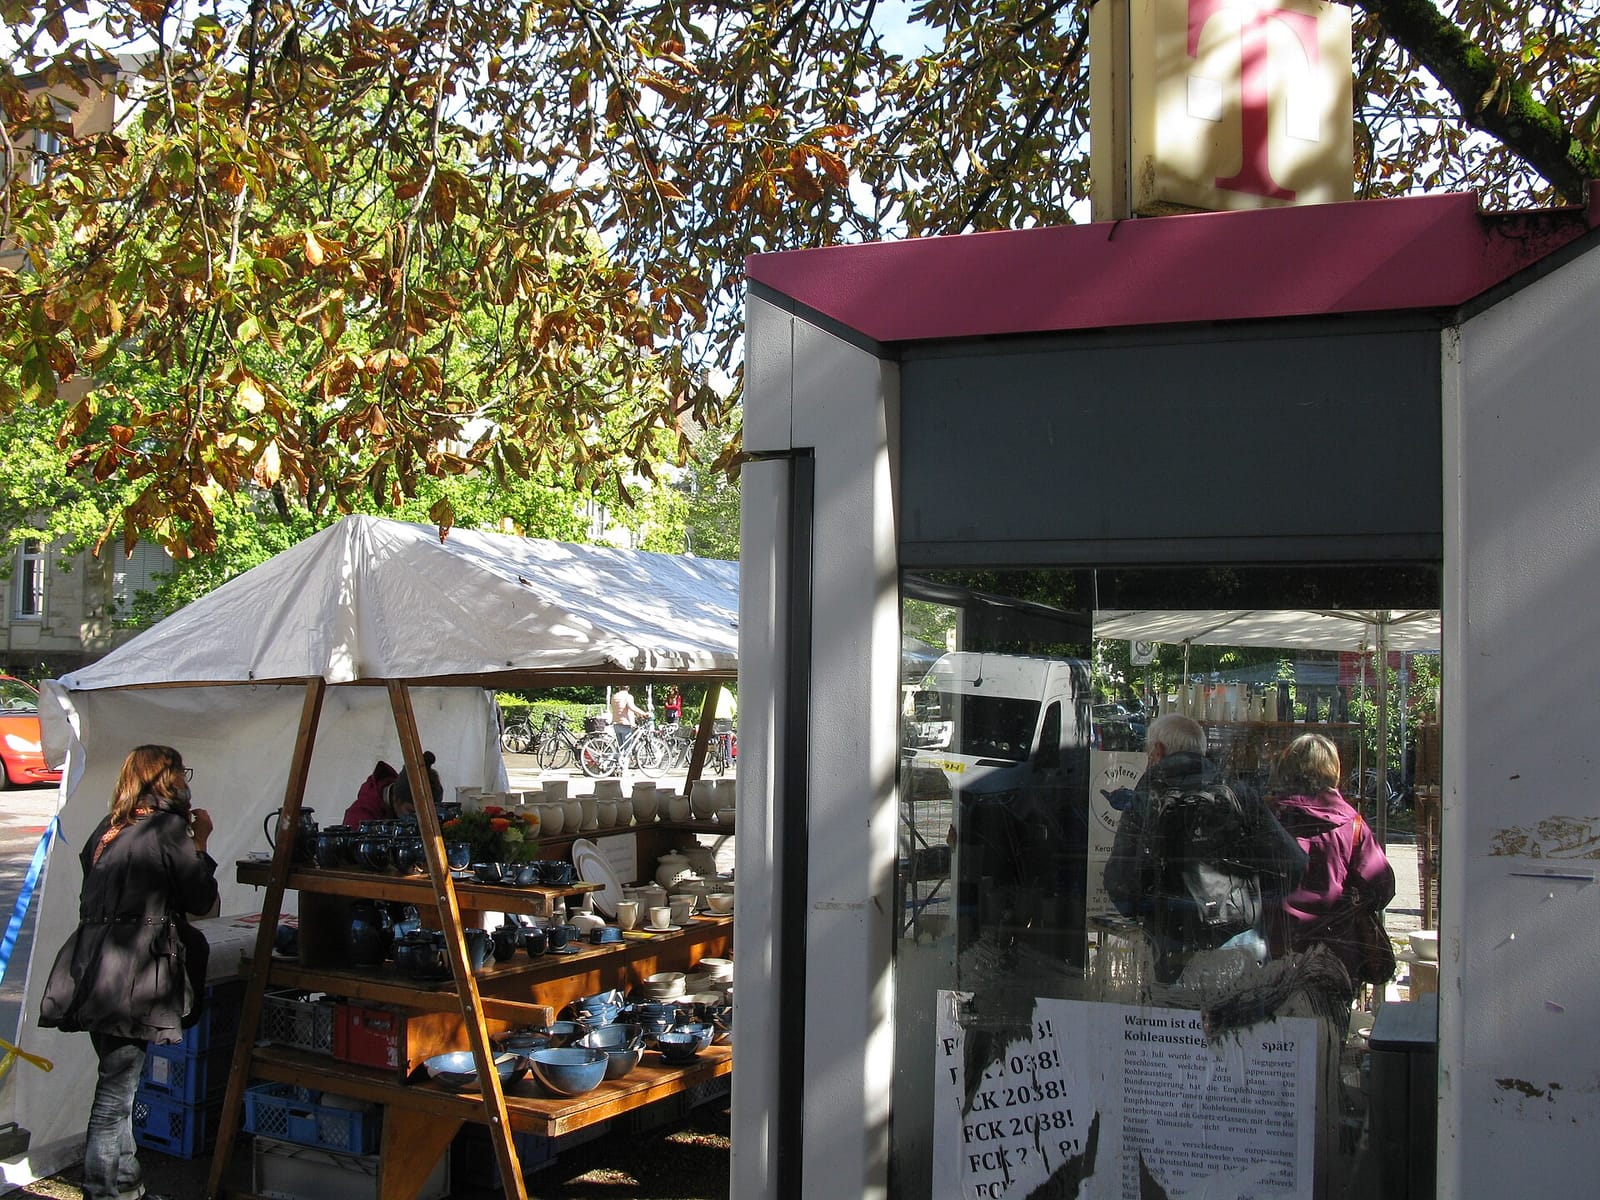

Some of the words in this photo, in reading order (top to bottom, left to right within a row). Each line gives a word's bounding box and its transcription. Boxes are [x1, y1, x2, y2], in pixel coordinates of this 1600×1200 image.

[1187, 0, 1319, 200] T
[1125, 1015, 1167, 1027] Warum
[1171, 1018, 1185, 1029] ist
[1189, 1019, 1203, 1030] de
[1124, 1030, 1208, 1049] Kohleausstieg
[1262, 1041, 1295, 1053] spät?
[998, 1049, 1060, 1078] 038!
[1152, 1050, 1164, 1058] Juli
[1168, 1052, 1191, 1060] wurde
[1124, 1059, 1168, 1069] beschlossen,
[1178, 1063, 1206, 1071] welches
[1124, 1068, 1173, 1079] Kohleausstieg
[1187, 1072, 1198, 1080] bis
[1213, 1074, 1232, 1083] 2038
[1283, 1080, 1295, 1088] Die
[1124, 1077, 1184, 1089] Bundesregierung
[1207, 1083, 1218, 1091] die
[1223, 1085, 1275, 1096] Empfehlungen
[1003, 1079, 1068, 1107] 2038!
[1205, 1094, 1238, 1103] ignoriert,
[1241, 1096, 1252, 1104] die
[1255, 1098, 1295, 1107] schwachen
[1123, 1096, 1174, 1107] Empfehlungen
[1202, 1103, 1266, 1115] Kohlekommission
[1274, 1110, 1294, 1118] sogar
[1123, 1106, 1162, 1116] unterboten
[1217, 1114, 1249, 1124] erlassen,
[1264, 1118, 1280, 1127] dem
[1283, 1120, 1294, 1128] die
[963, 1120, 1007, 1143] FCK
[1157, 1119, 1194, 1128] Klimaziele
[1265, 1129, 1294, 1137] werden
[1123, 1135, 1155, 1145] Während
[1182, 1142, 1234, 1152] verschiedenen
[1244, 1147, 1294, 1158] europäischen
[1153, 1147, 1164, 1155] die
[1166, 1149, 1189, 1157] ersten
[1191, 1151, 1231, 1161] Kraftwerke
[969, 1149, 1013, 1173] FCK
[1160, 1157, 1204, 1169] Deutschland
[1207, 1162, 1219, 1170] mit
[1256, 1177, 1294, 1188] raftwerk
